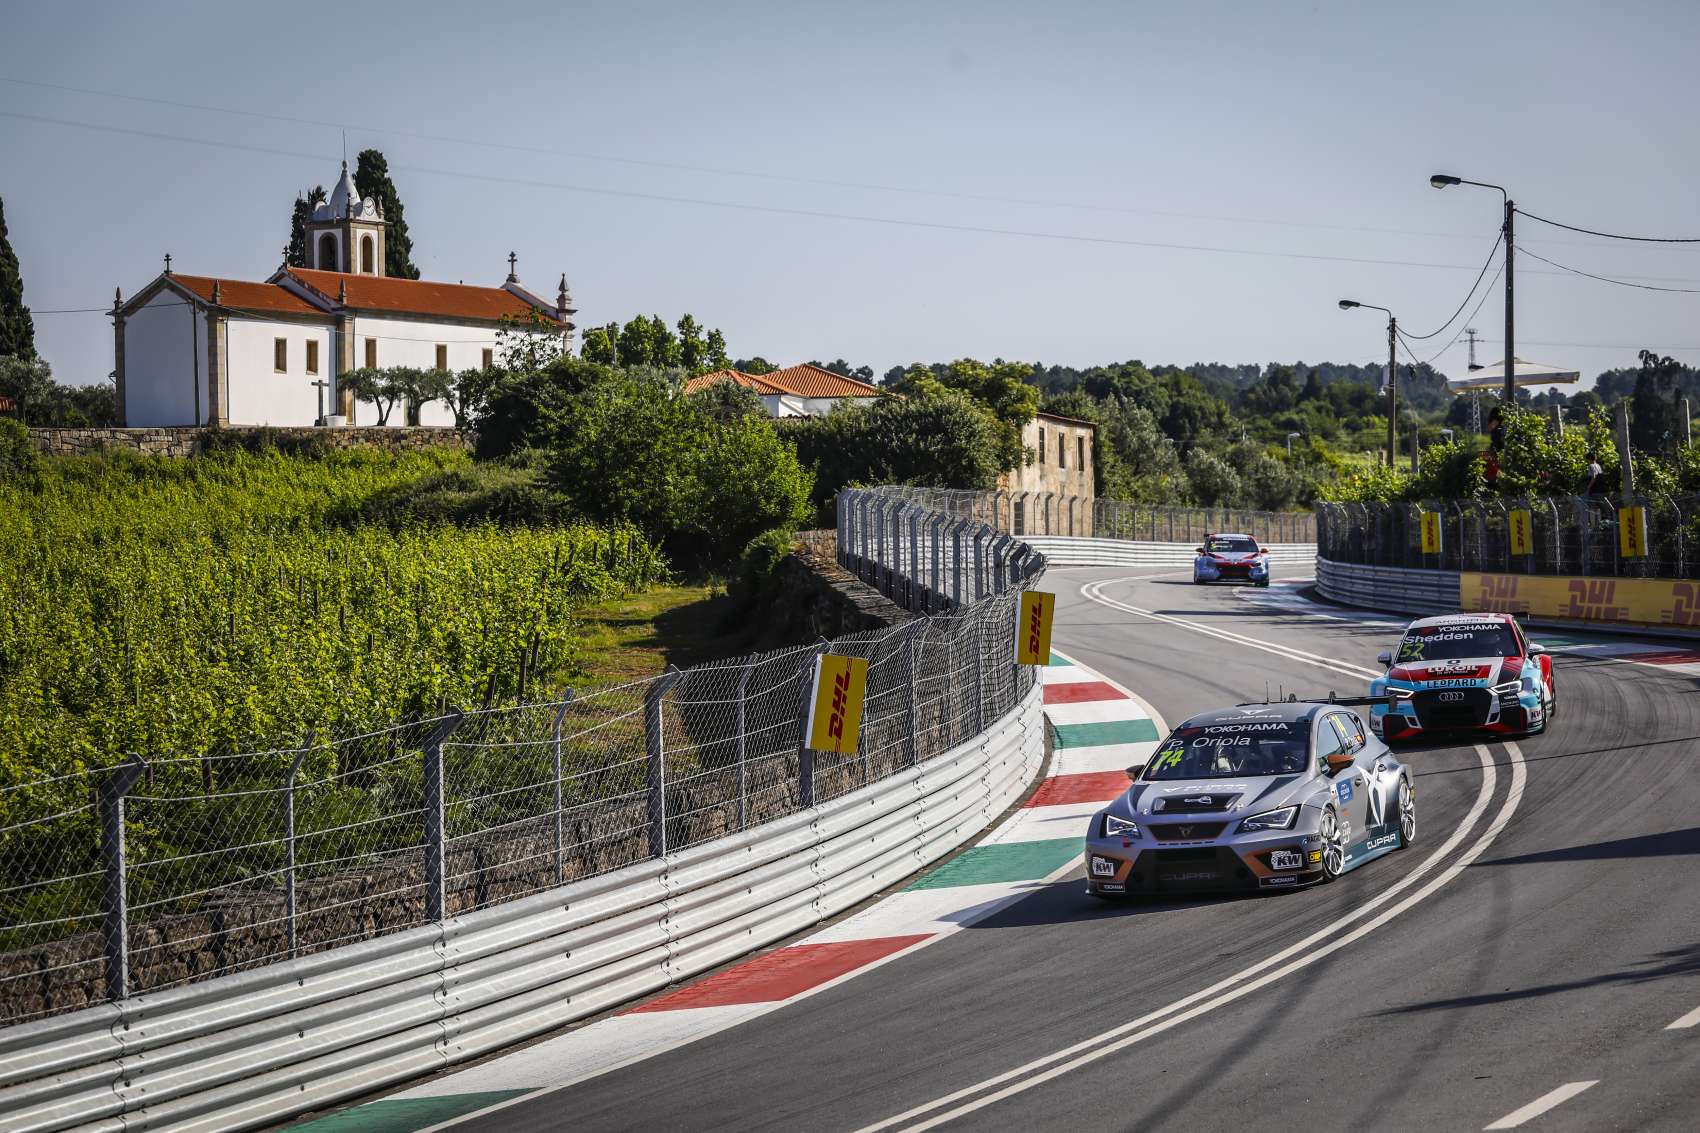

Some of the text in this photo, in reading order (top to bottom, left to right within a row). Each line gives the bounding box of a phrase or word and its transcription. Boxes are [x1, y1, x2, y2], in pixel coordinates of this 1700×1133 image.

[1427, 518, 1435, 548] DHL
[1516, 517, 1524, 547] DHL
[1628, 517, 1636, 548] DHL
[1480, 575, 1619, 619] DHL DHL
[1028, 602, 1043, 656] DHL
[1438, 623, 1502, 633] YOKOHAMA
[1404, 631, 1474, 644] Shedden
[1400, 642, 1426, 659] 52
[1427, 664, 1479, 673] LUKOIL
[1426, 678, 1477, 689] LEOPARD
[828, 672, 852, 741] DHL
[1204, 722, 1289, 734] YOKOHAMA
[1192, 735, 1251, 749] Oriola
[1151, 747, 1185, 770] 74
[1366, 832, 1397, 850] CUPRA
[1095, 862, 1113, 874] KW
[1274, 854, 1301, 867] KW
